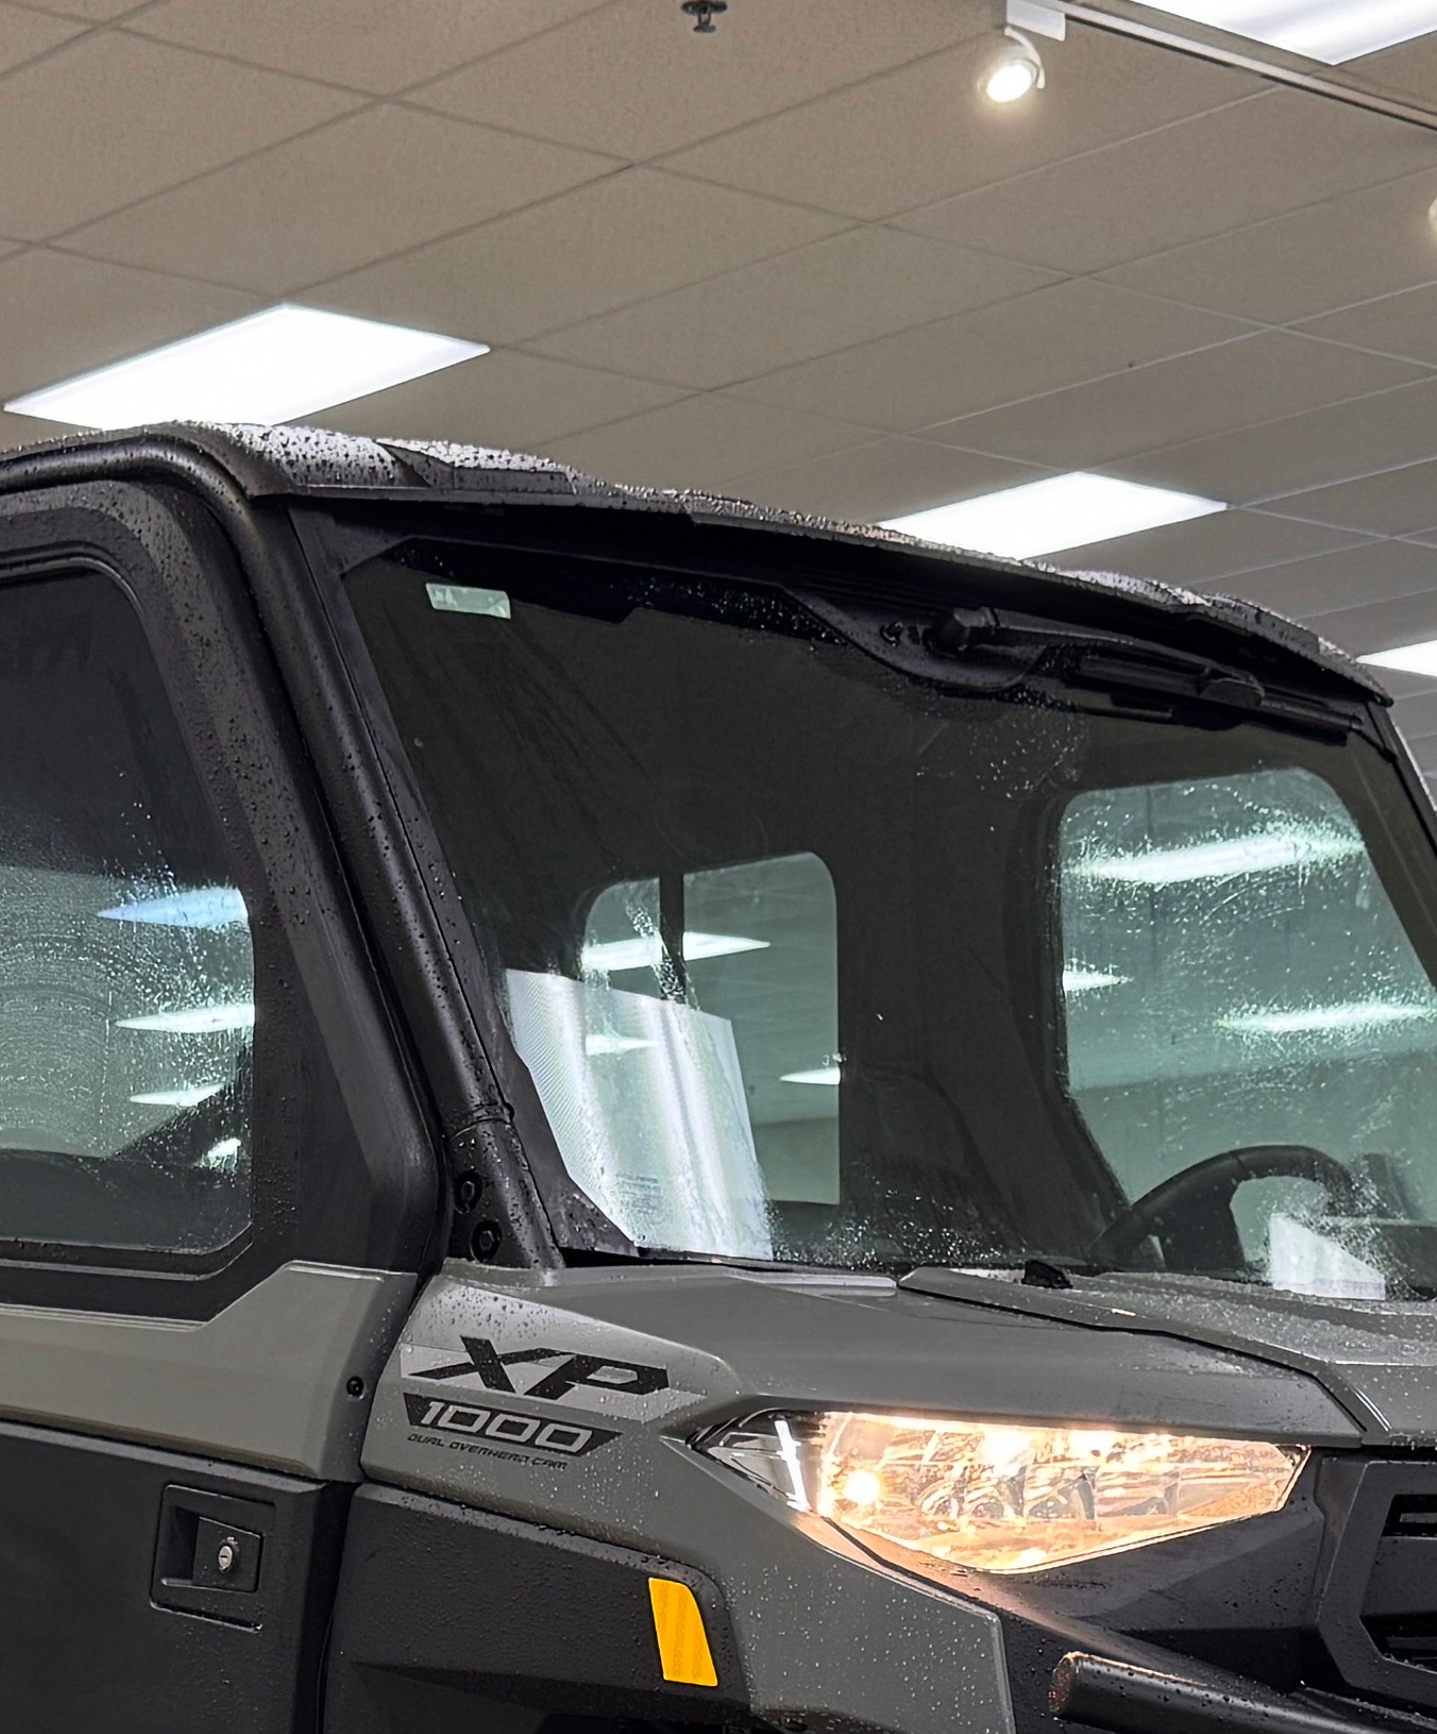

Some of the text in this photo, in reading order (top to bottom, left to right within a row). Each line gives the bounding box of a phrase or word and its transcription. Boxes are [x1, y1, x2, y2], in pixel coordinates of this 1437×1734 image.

[409, 1335, 669, 1401] XP
[407, 1432, 569, 1470] DUAL OVERHEAD CAM
[420, 1400, 593, 1454] 1000
